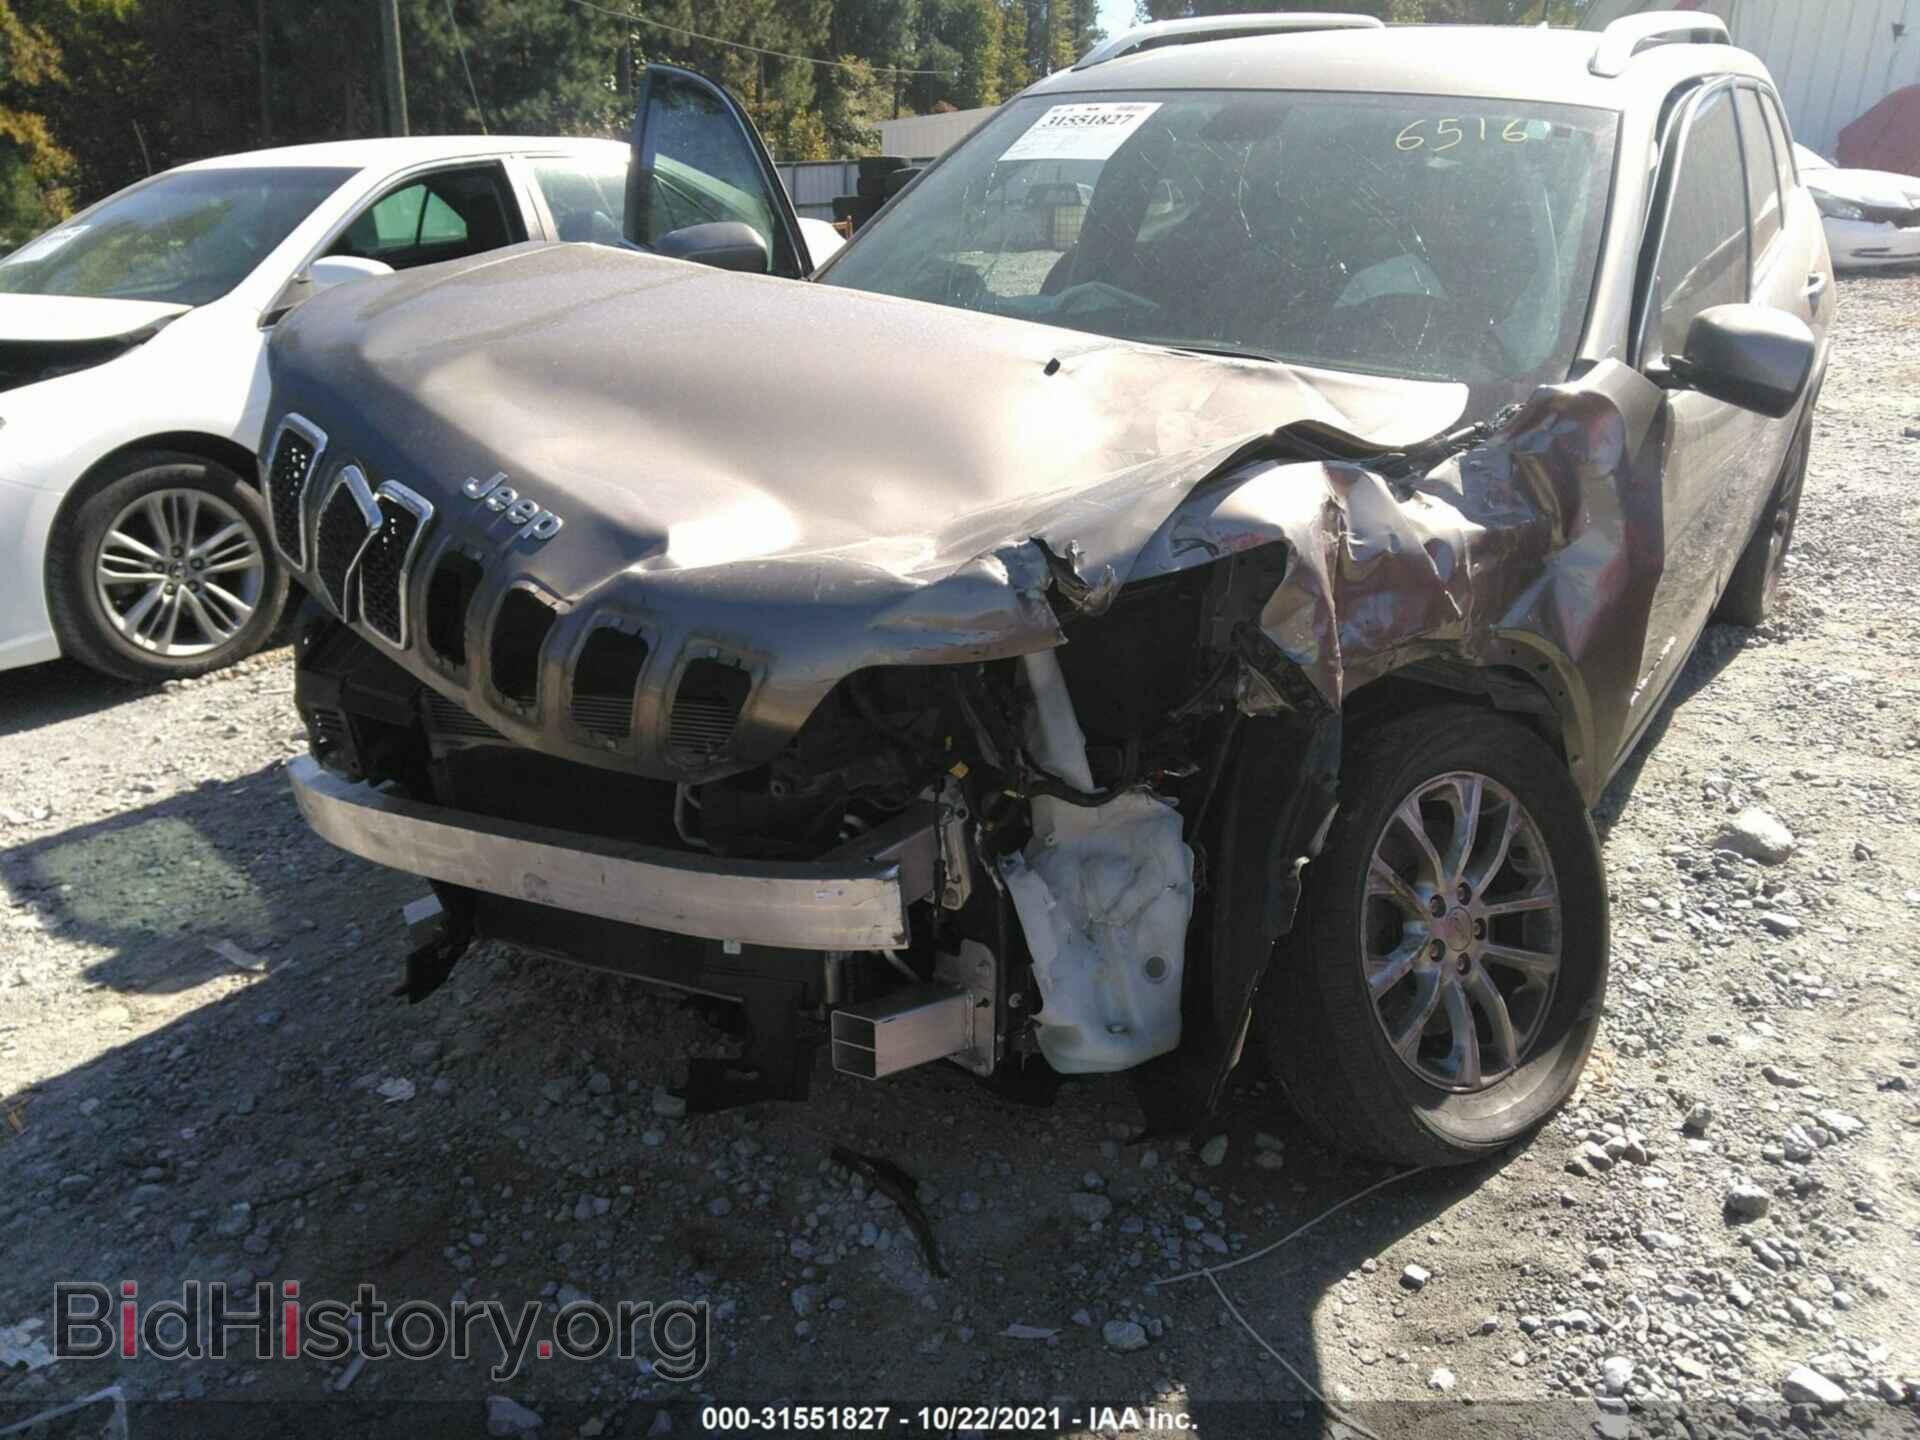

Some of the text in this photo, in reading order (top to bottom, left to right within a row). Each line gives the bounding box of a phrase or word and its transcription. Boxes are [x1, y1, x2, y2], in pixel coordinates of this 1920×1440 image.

[1042, 113, 1136, 128] 31551827
[1395, 117, 1529, 151] 6516
[463, 471, 564, 540] Jeep
